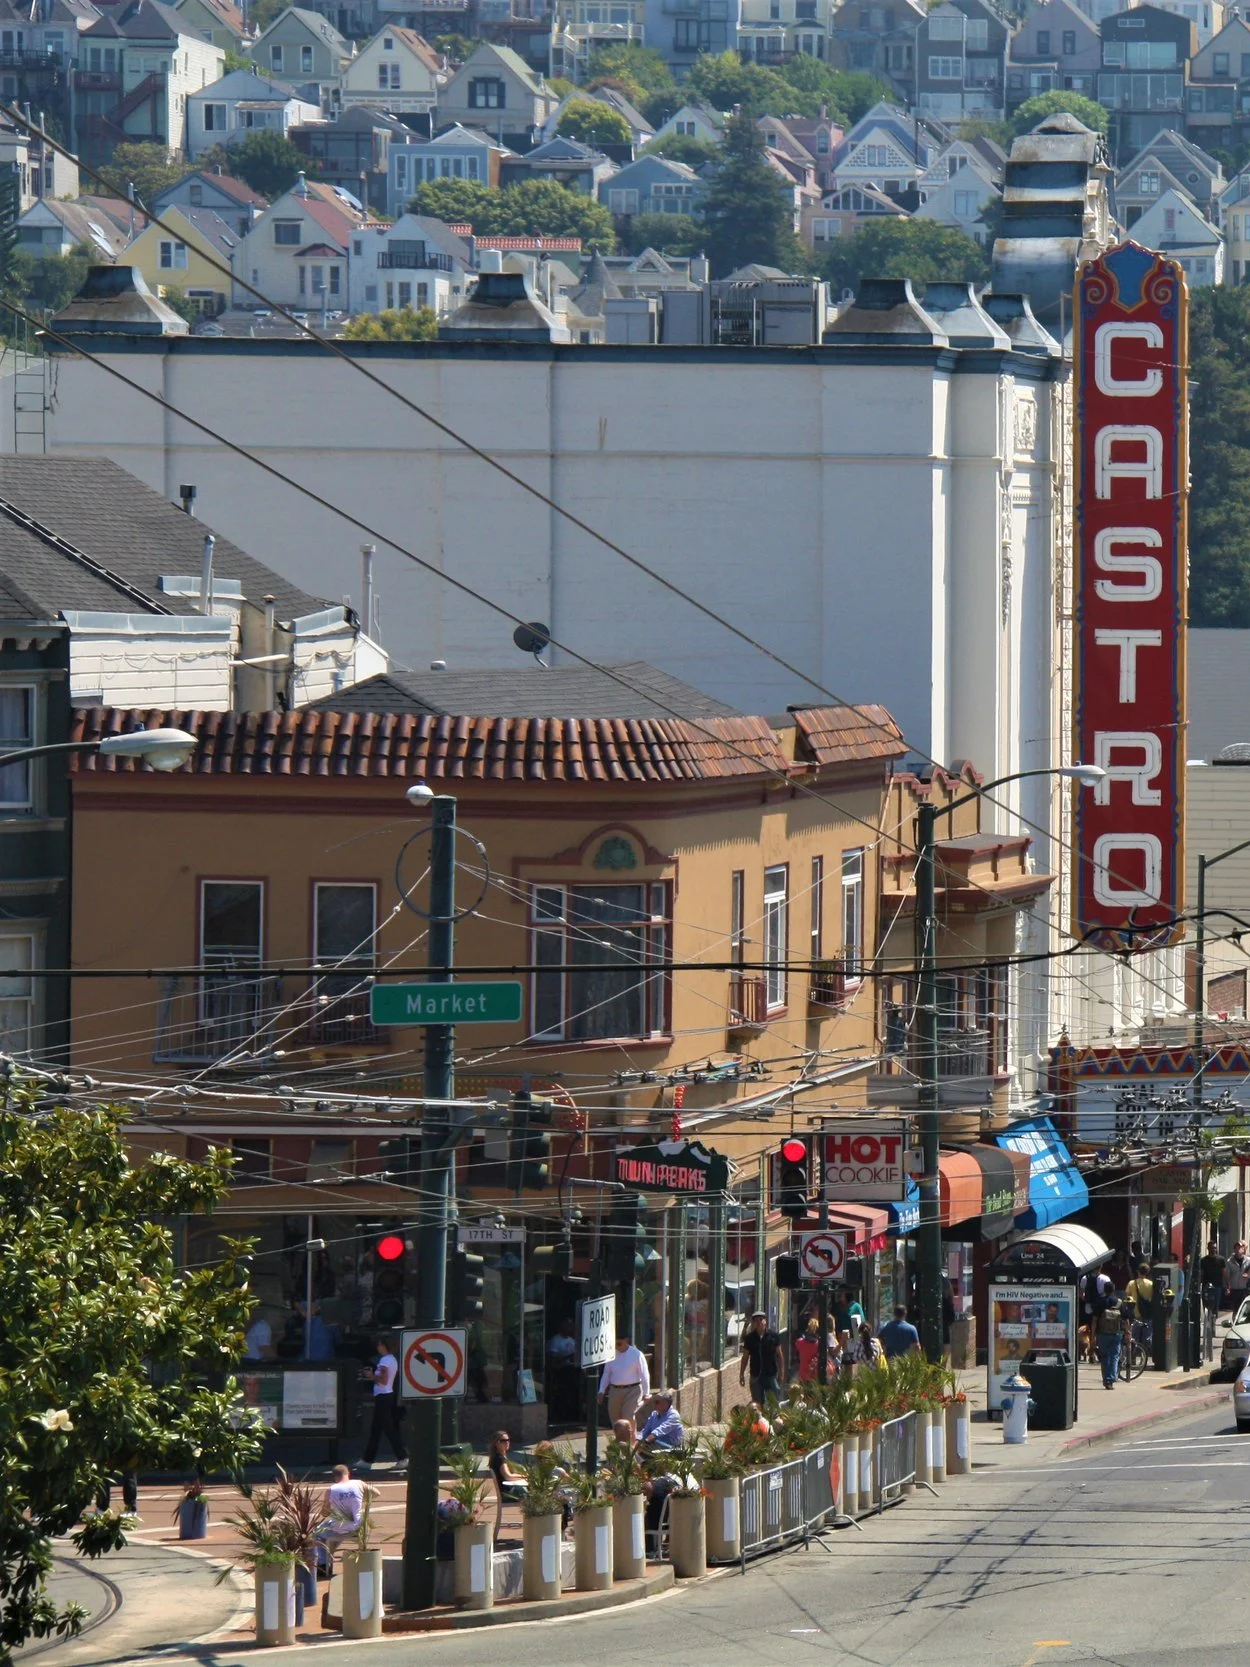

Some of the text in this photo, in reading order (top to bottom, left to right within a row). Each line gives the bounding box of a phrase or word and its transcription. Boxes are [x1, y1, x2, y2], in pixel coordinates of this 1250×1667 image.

[1093, 321, 1164, 907] CASTRO
[406, 994, 487, 1014] Market
[825, 1135, 902, 1165] HOT
[825, 1166, 899, 1183] COOKIE
[469, 1230, 514, 1240] 17TH ST
[1006, 1291, 1019, 1299] HIV
[1020, 1291, 1050, 1300] Negative
[589, 1306, 610, 1329] ROAD
[583, 1335, 612, 1357] CLOS
